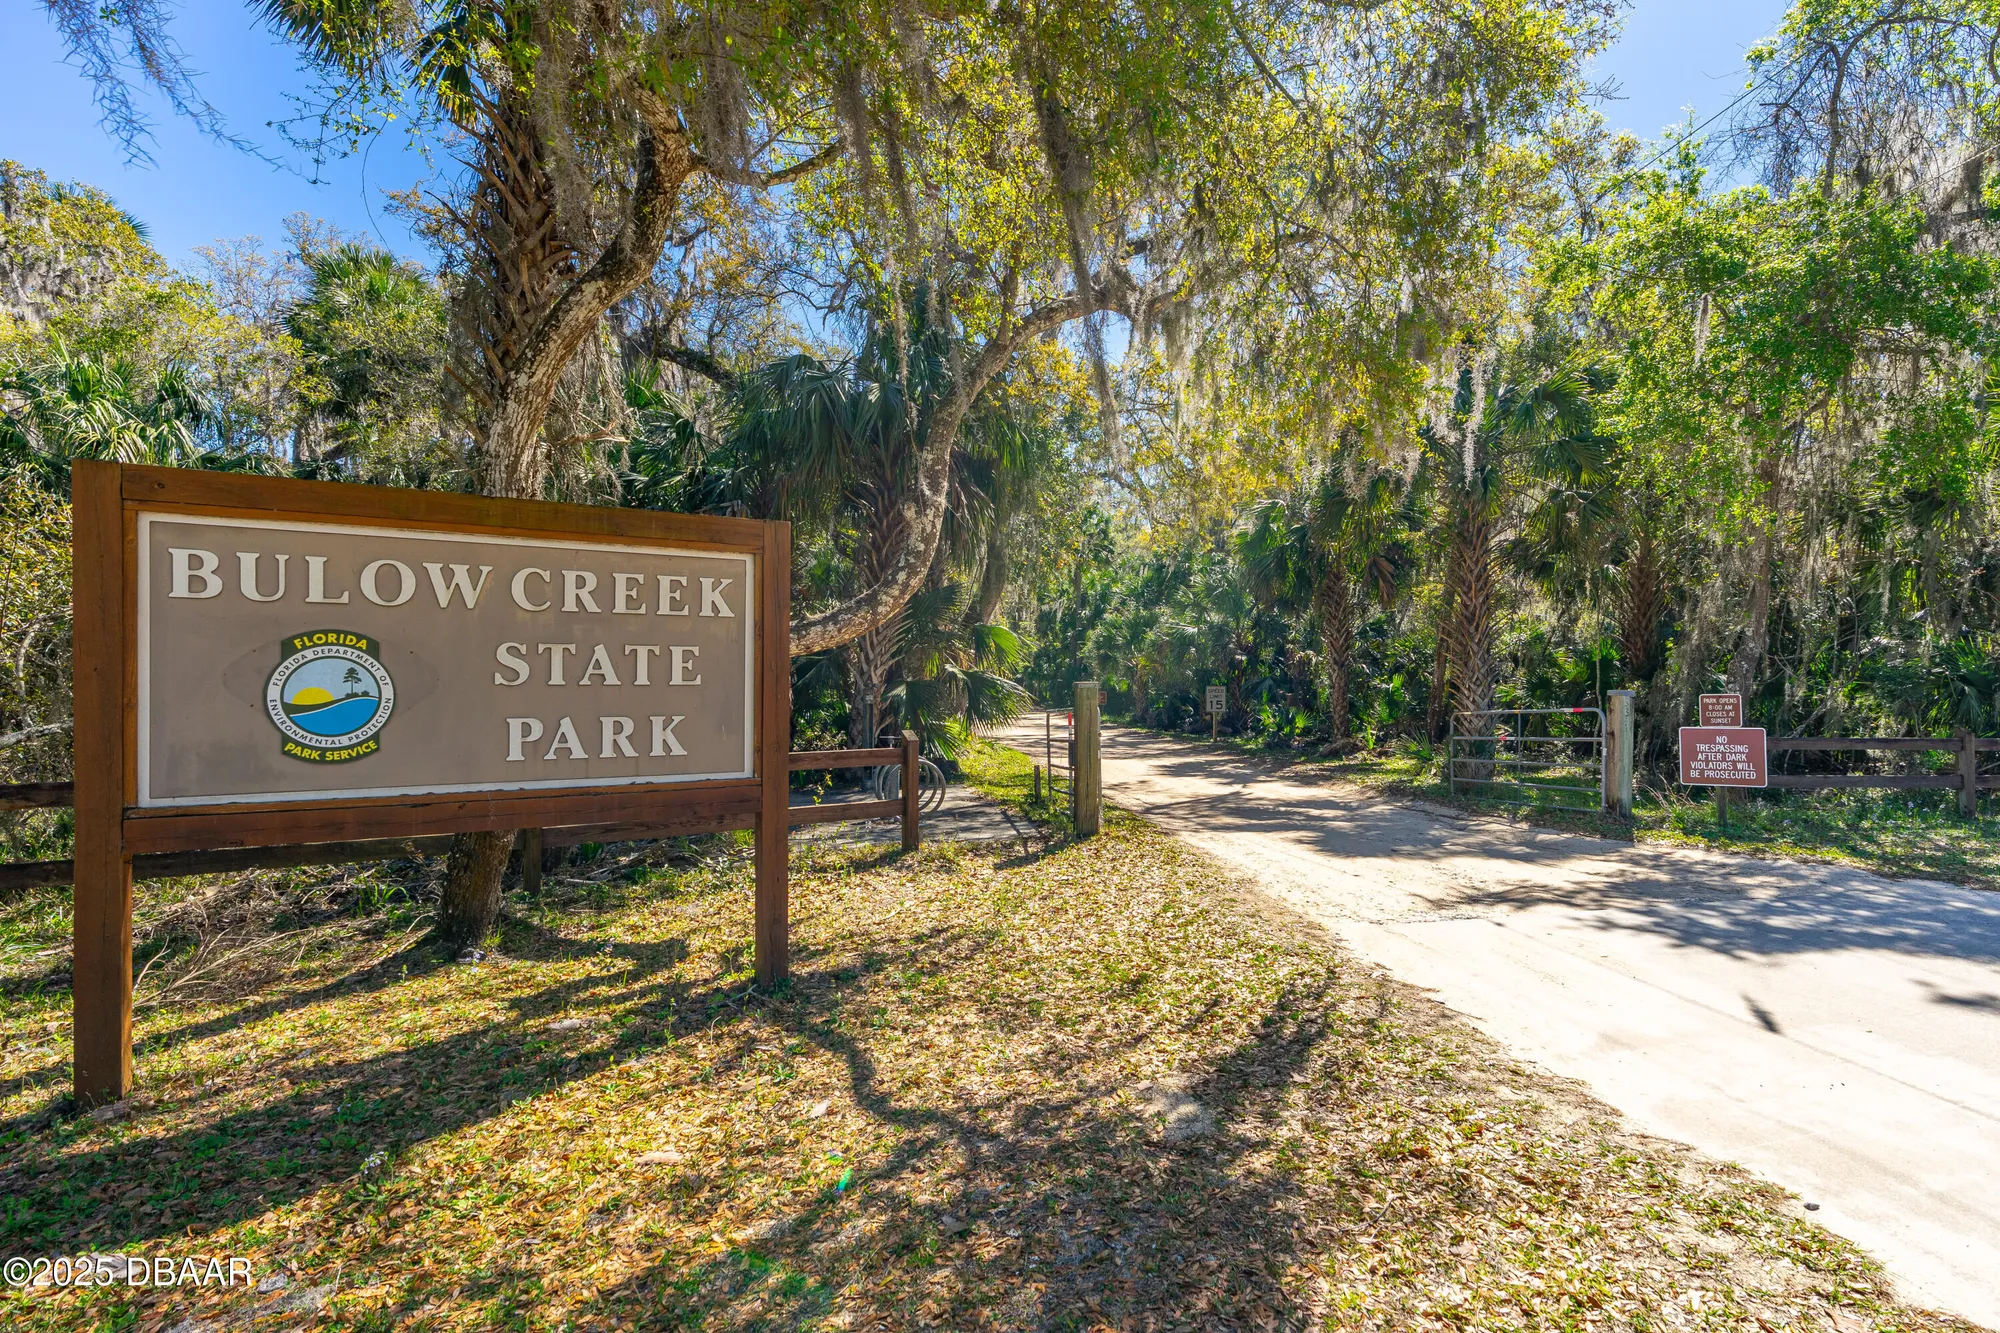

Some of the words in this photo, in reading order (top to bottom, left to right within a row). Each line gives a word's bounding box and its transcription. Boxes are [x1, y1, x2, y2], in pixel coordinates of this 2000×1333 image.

[168, 548, 493, 609] BULOW
[511, 567, 736, 618] CREEK
[293, 633, 368, 650] FLORIDA
[272, 653, 308, 687] FLORIDA
[312, 648, 380, 672] DEPARTMENT
[379, 675, 389, 686] OF
[494, 642, 702, 686] STATE
[1210, 700, 1223, 710] 15
[269, 698, 343, 745] ENVIRONMENTAL
[347, 697, 392, 743] PROTECTION
[506, 715, 689, 762] PARK
[1696, 744, 1748, 752] TRESPASSING
[284, 742, 320, 760] PARK
[325, 740, 378, 761] SERVICE
[1690, 762, 1732, 770] VIOLATORS
[1736, 762, 1755, 770] WILL
[1704, 770, 1756, 779] PROSECUTED
